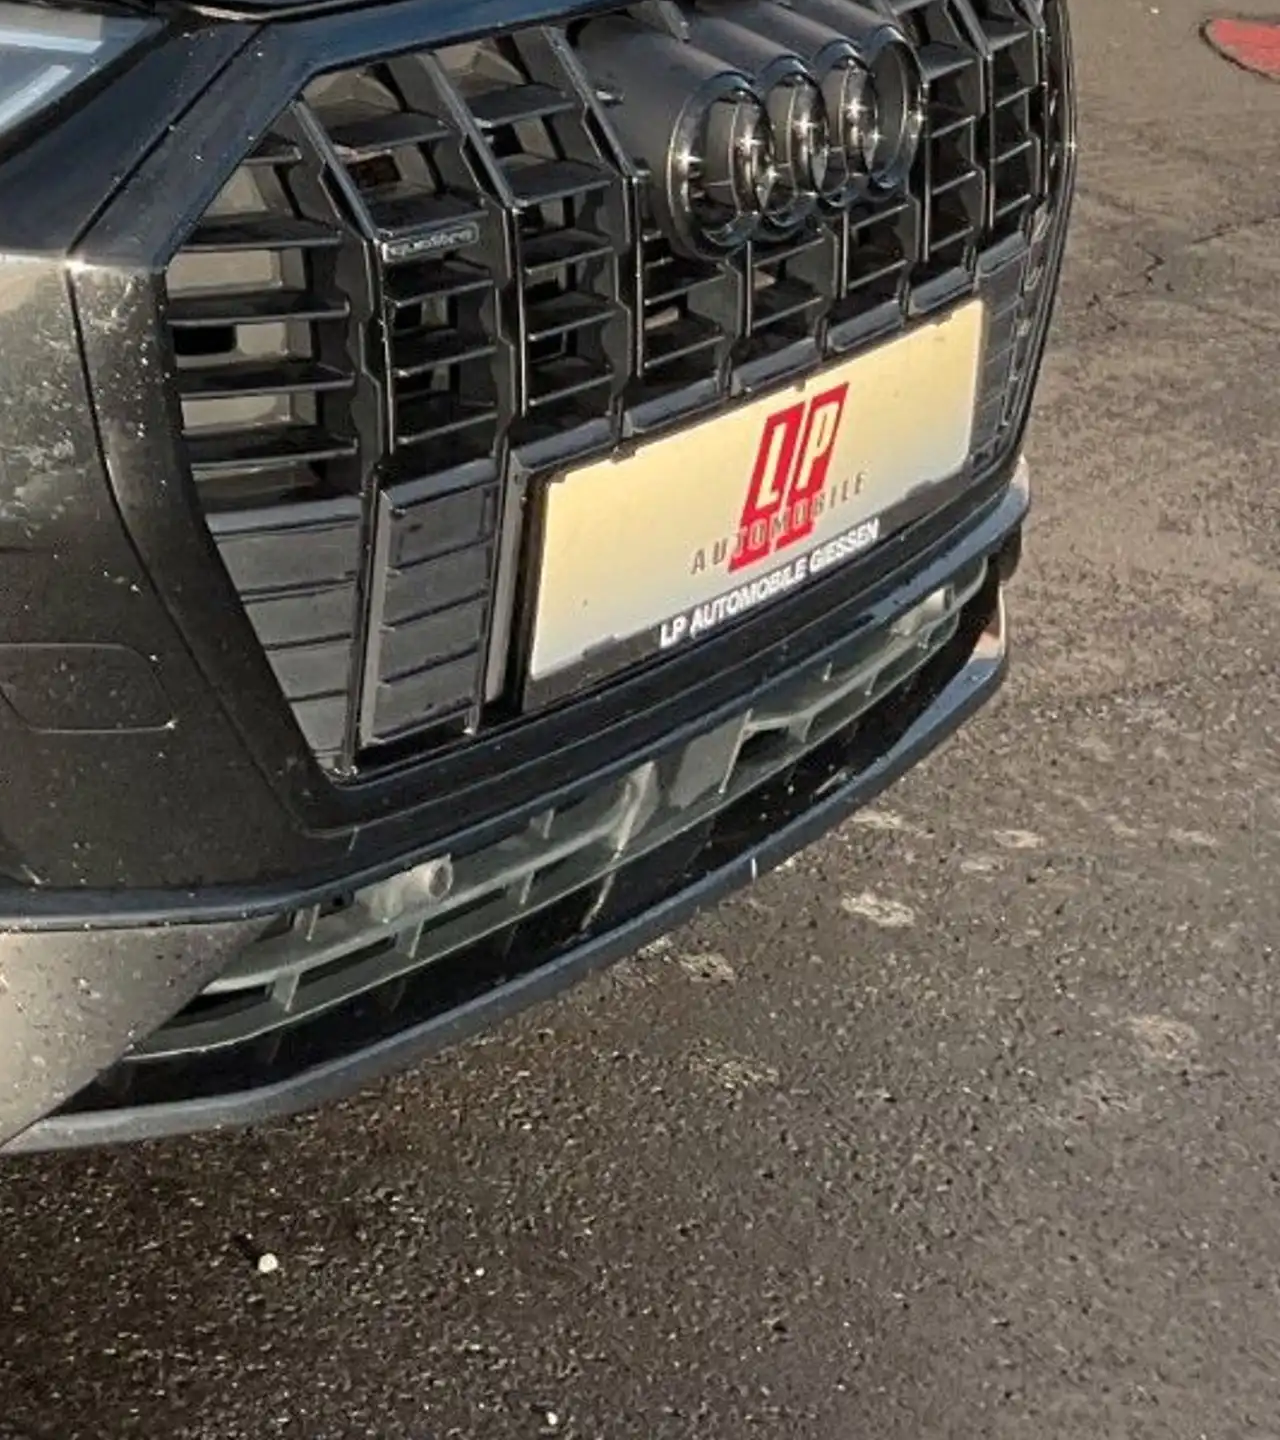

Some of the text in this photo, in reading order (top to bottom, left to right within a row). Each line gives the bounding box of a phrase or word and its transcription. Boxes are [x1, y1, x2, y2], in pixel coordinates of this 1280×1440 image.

[750, 396, 843, 511] LP
[658, 616, 688, 649] LP
[689, 557, 809, 634] AUTOMOBILE
